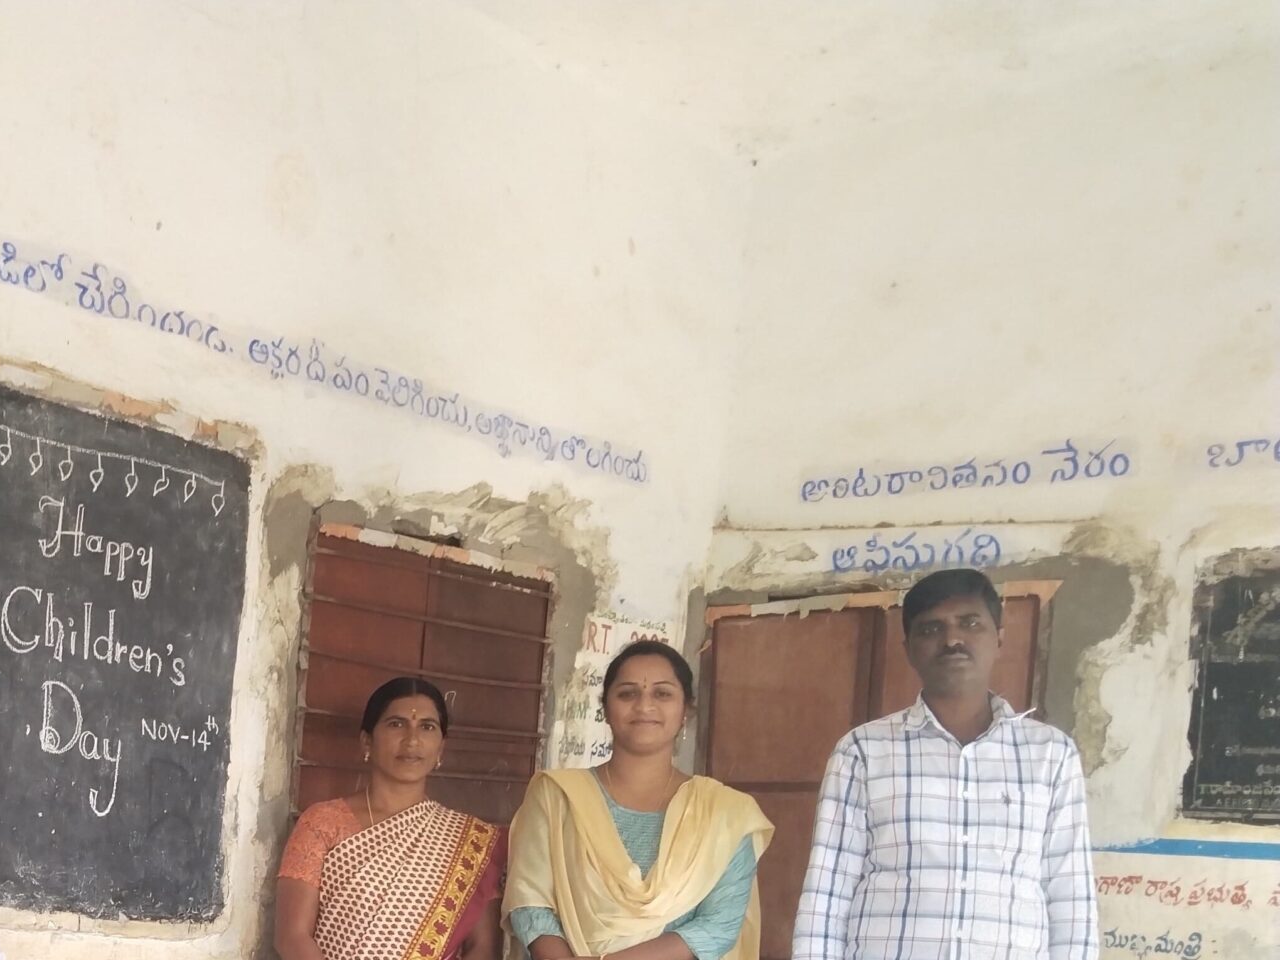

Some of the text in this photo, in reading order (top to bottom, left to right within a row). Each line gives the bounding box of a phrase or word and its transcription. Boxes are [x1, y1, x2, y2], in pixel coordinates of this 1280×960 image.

[1041, 438, 1130, 484] నేరం
[38, 496, 154, 599] Happy
[1, 586, 186, 687] Children's
[39, 681, 121, 816] Day
